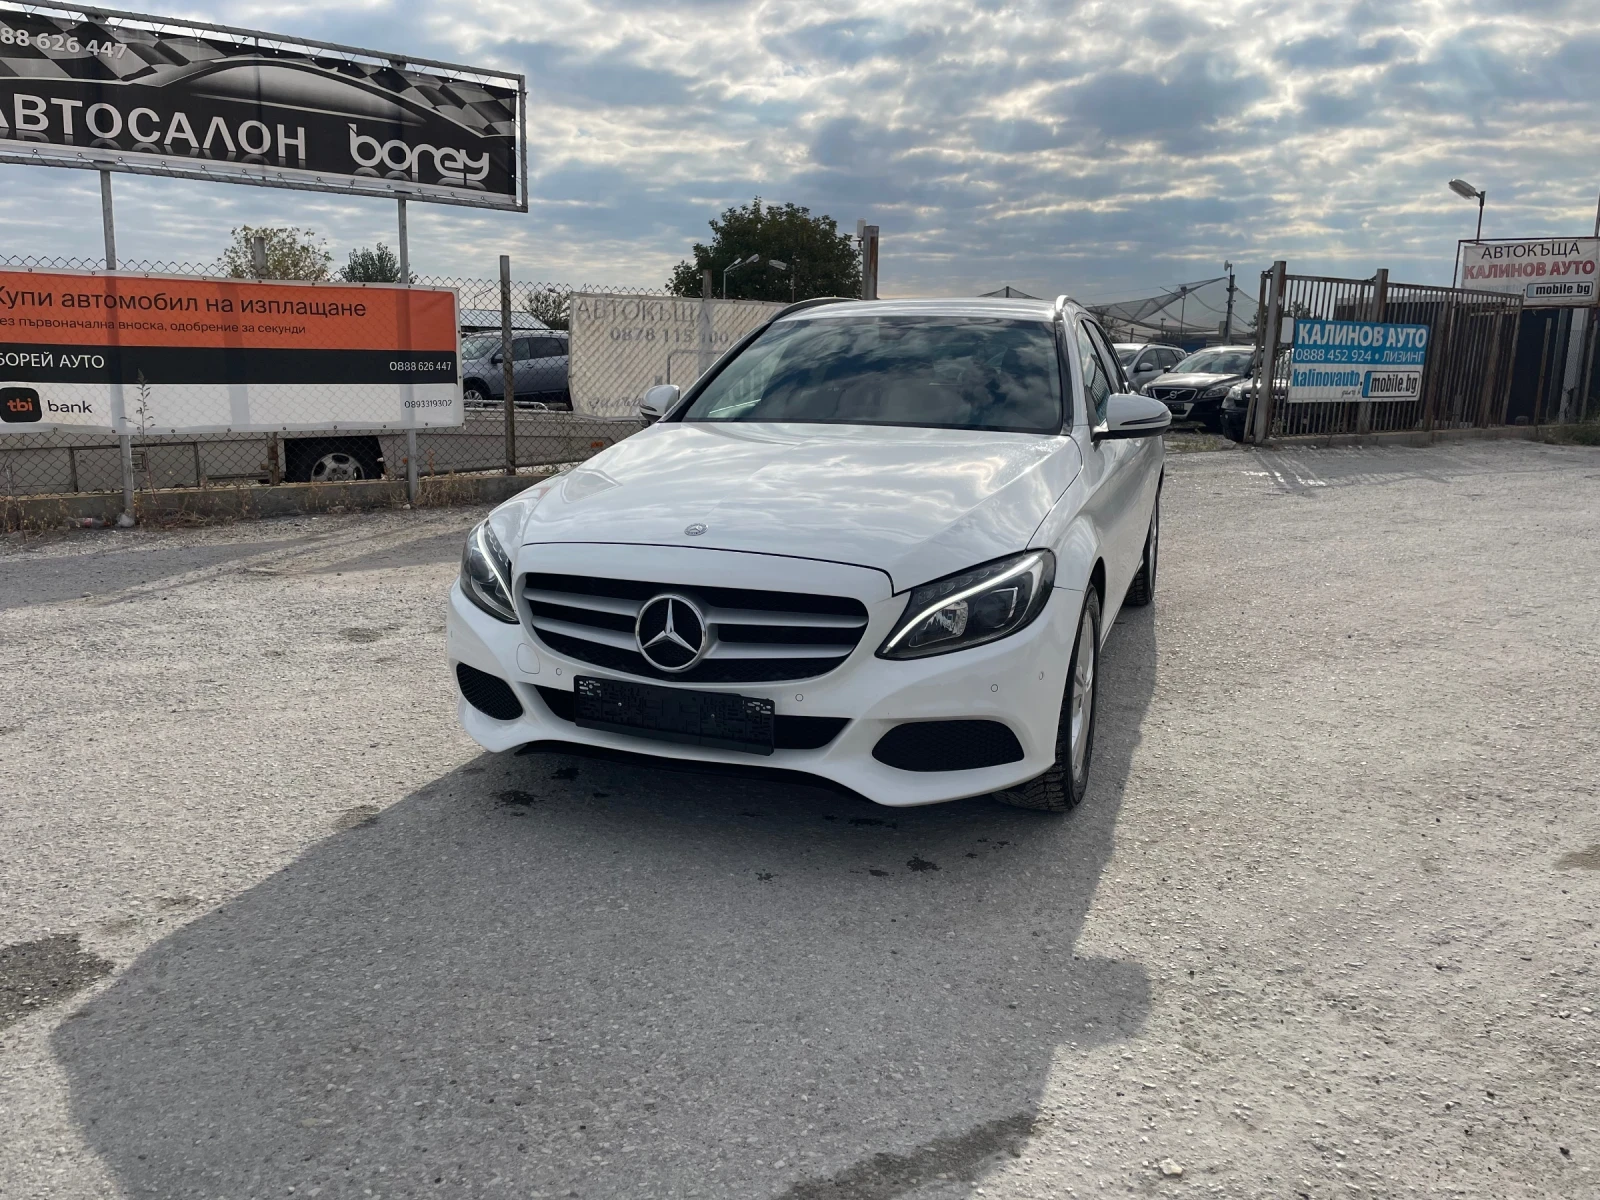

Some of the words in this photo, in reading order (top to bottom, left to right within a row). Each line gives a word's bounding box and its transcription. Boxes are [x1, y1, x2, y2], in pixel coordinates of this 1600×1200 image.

[36, 32, 80, 53] 626
[85, 39, 127, 59] 447
[348, 122, 490, 180] borey
[1481, 241, 1580, 259] АВТОКЪЩА
[1464, 261, 1547, 280] КАЛИНОВ
[1549, 259, 1596, 276] АУТО
[61, 291, 199, 312] автомобил
[206, 295, 234, 313] на
[241, 297, 367, 319] изплащане
[19, 318, 115, 330] първоначална
[118, 321, 167, 333] вноска,
[170, 321, 239, 335] одобрение
[241, 324, 255, 333] за
[258, 324, 306, 336] секунди
[1297, 323, 1384, 347] КАЛИНОВ
[1385, 327, 1427, 348] АУТО
[59, 354, 105, 369] АУТО
[1295, 348, 1325, 361] 0888
[1327, 349, 1348, 361] 452
[1351, 350, 1371, 362] 924
[1381, 350, 1425, 363] ЛИЗИНГ
[389, 361, 416, 371] 0888
[418, 361, 434, 371] 626
[436, 361, 452, 371] 447
[7, 397, 33, 412] tbi
[47, 399, 93, 414] bank
[404, 399, 453, 409] 0893319302
